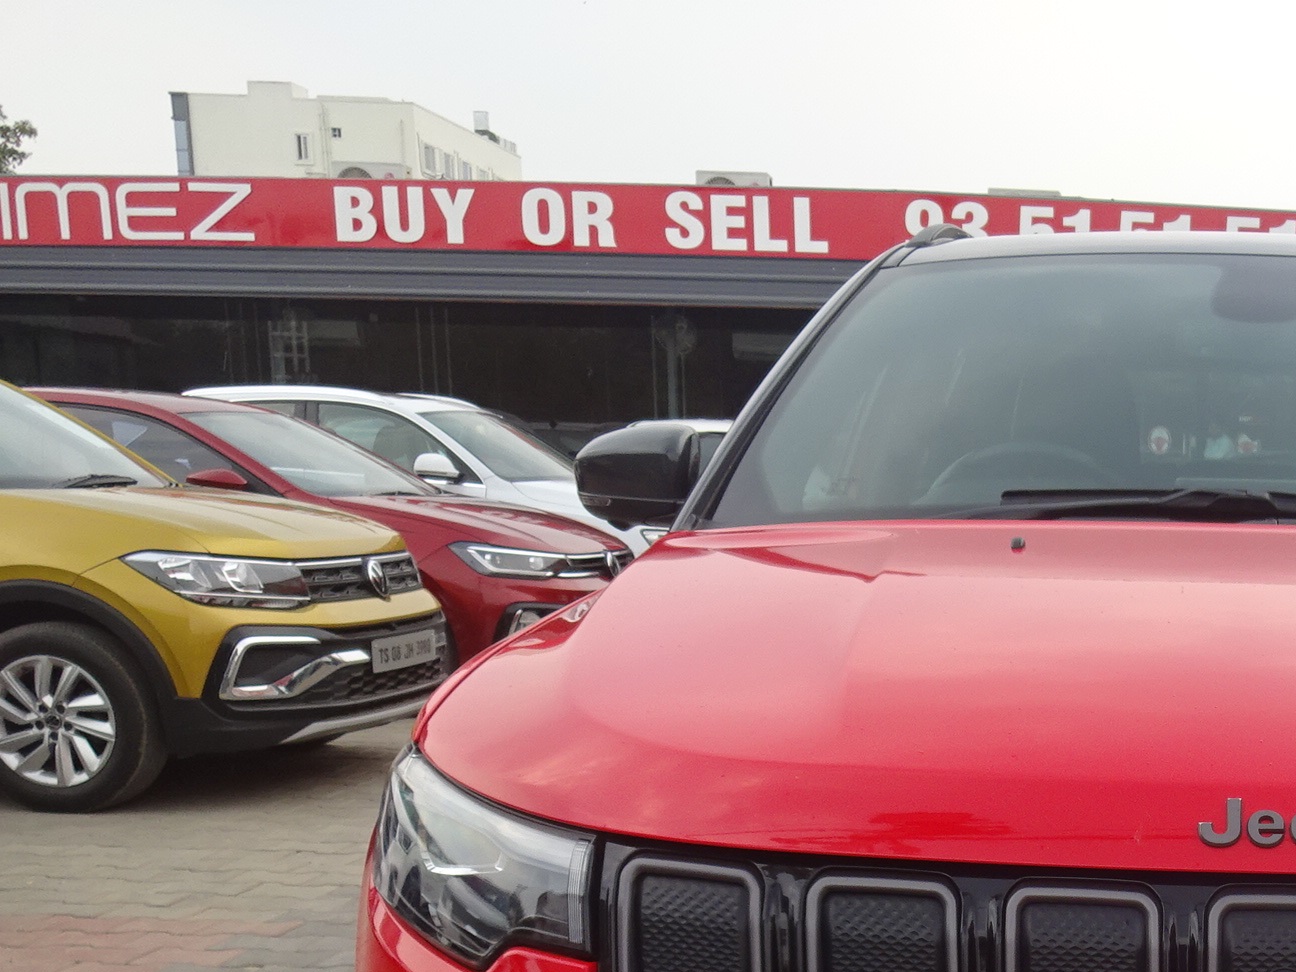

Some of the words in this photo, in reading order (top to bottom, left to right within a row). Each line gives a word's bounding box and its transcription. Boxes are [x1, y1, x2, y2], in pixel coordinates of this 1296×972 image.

[333, 185, 476, 245] BUY
[521, 187, 618, 248] OR
[664, 190, 829, 254] SELL
